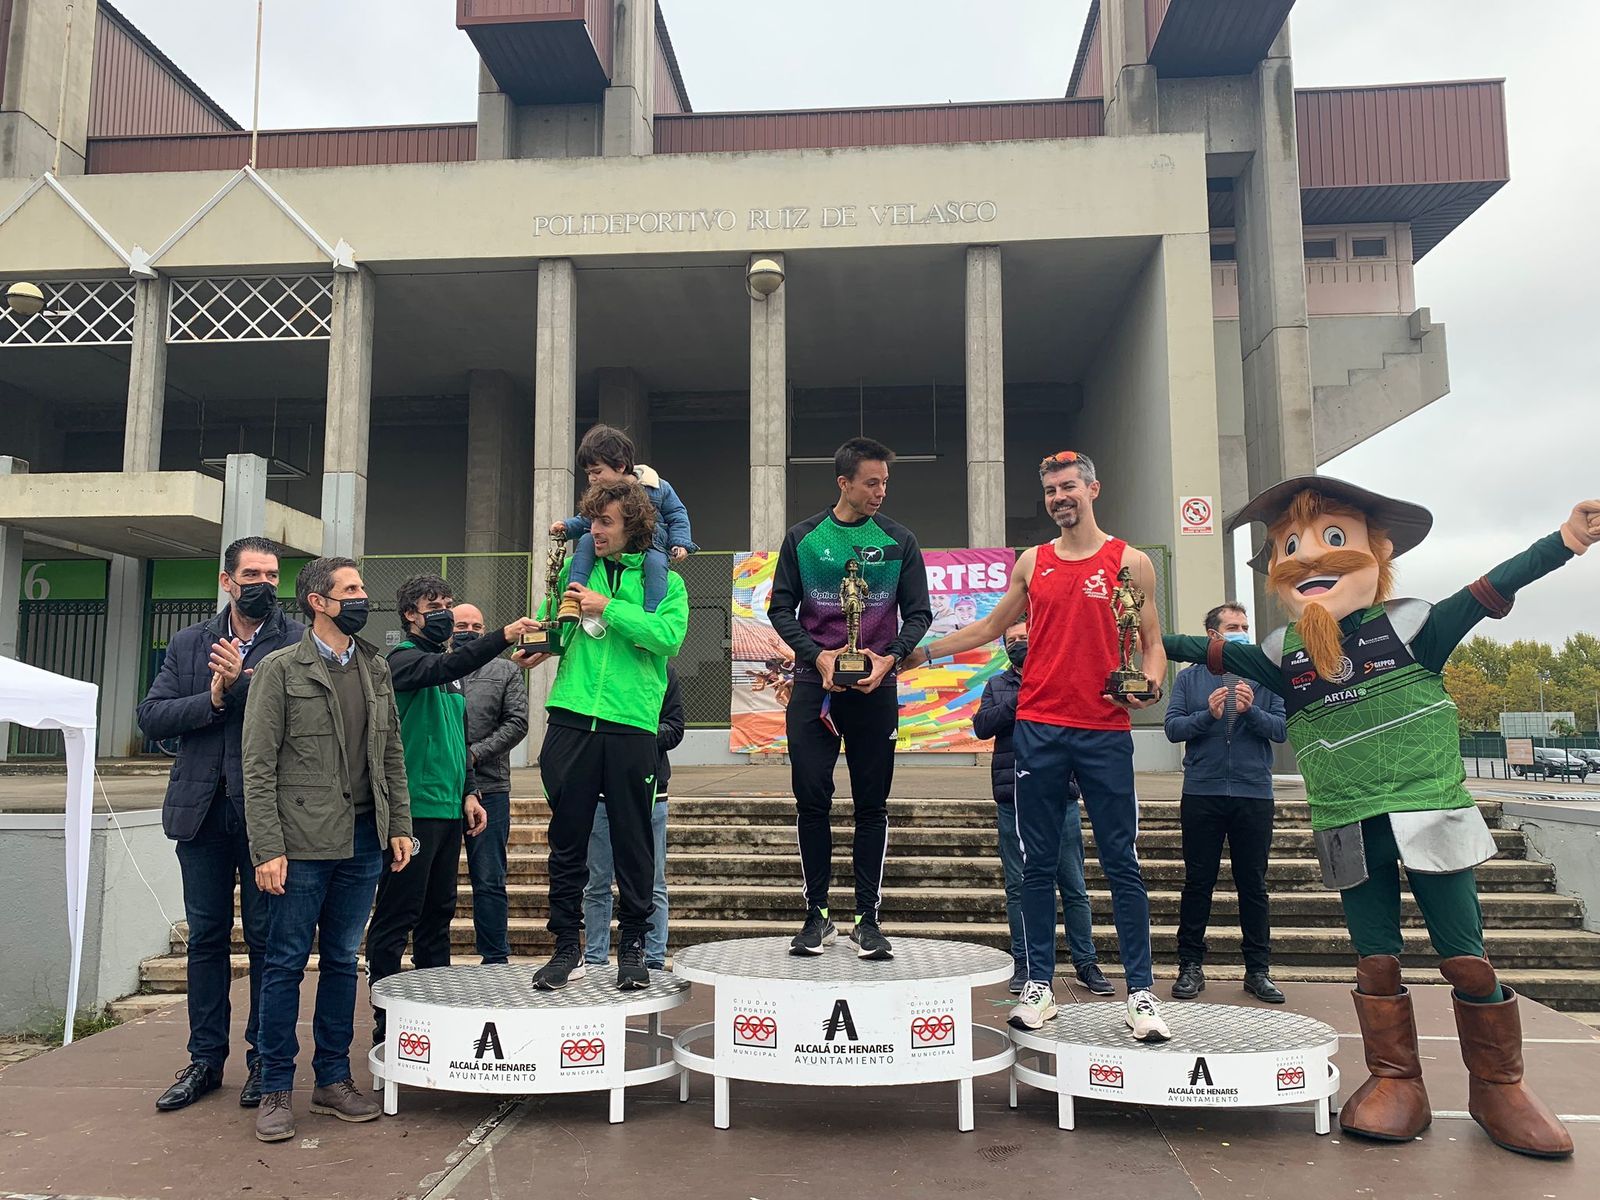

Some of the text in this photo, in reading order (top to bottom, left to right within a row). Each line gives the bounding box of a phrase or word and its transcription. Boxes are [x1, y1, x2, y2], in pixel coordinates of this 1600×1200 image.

[533, 200, 997, 237] POLIDEPORTIVO RUIZ DE VELASCO
[24, 563, 51, 600] 6
[924, 562, 1008, 591] RTES
[1324, 689, 1358, 704] ARTAI
[733, 998, 777, 1007] CIUDAD
[910, 999, 954, 1007] CIUDAD
[733, 1006, 777, 1015] DEPORTIVA
[910, 1007, 954, 1015] DEPORTIVA
[399, 1017, 431, 1026] CIUDAD
[399, 1024, 431, 1034] DEPORTIVA
[560, 1023, 605, 1031] CIUDAD
[733, 1048, 777, 1058] MUNICIPAL
[794, 1042, 894, 1054] ALCALÁ DE HENARES
[911, 1049, 955, 1058] MUNICIPAL
[794, 1055, 894, 1065] AYUNTAMIENTO
[397, 1062, 430, 1072] MUNICIPAL
[449, 1060, 536, 1072] ALCALÁ DE HENARES
[449, 1071, 536, 1082] AYUNTAMIENTO
[560, 1069, 605, 1077] MUNICIPAL
[1167, 1086, 1195, 1095] ALCALÁ
[1168, 1095, 1239, 1103] AYUNTAMIENTO
